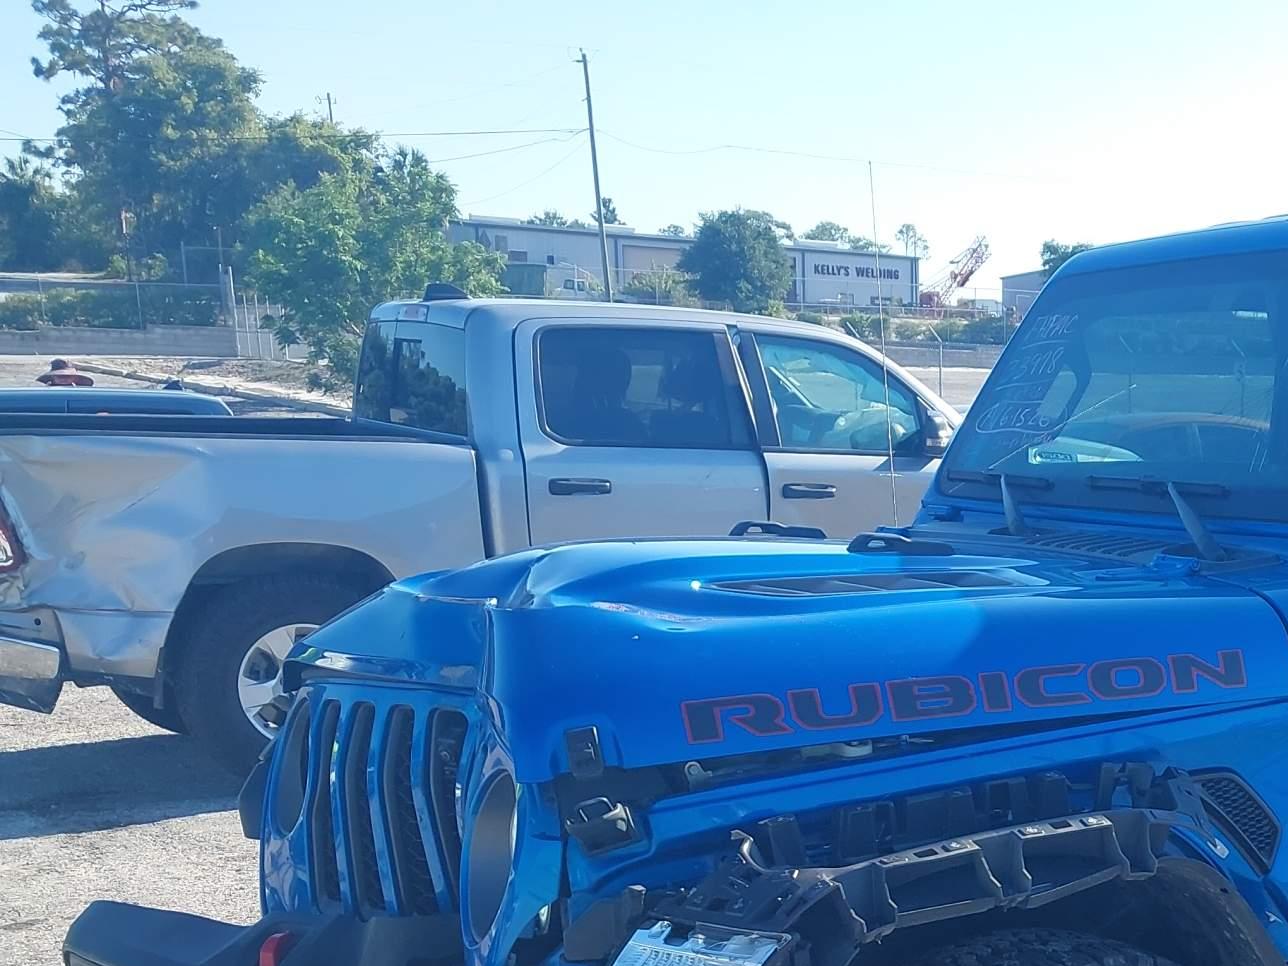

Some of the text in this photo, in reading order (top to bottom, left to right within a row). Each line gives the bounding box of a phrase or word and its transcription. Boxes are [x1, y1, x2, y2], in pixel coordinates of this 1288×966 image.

[814, 263, 900, 280] KELLY'S WELDING
[682, 649, 1247, 745] RUBICON
